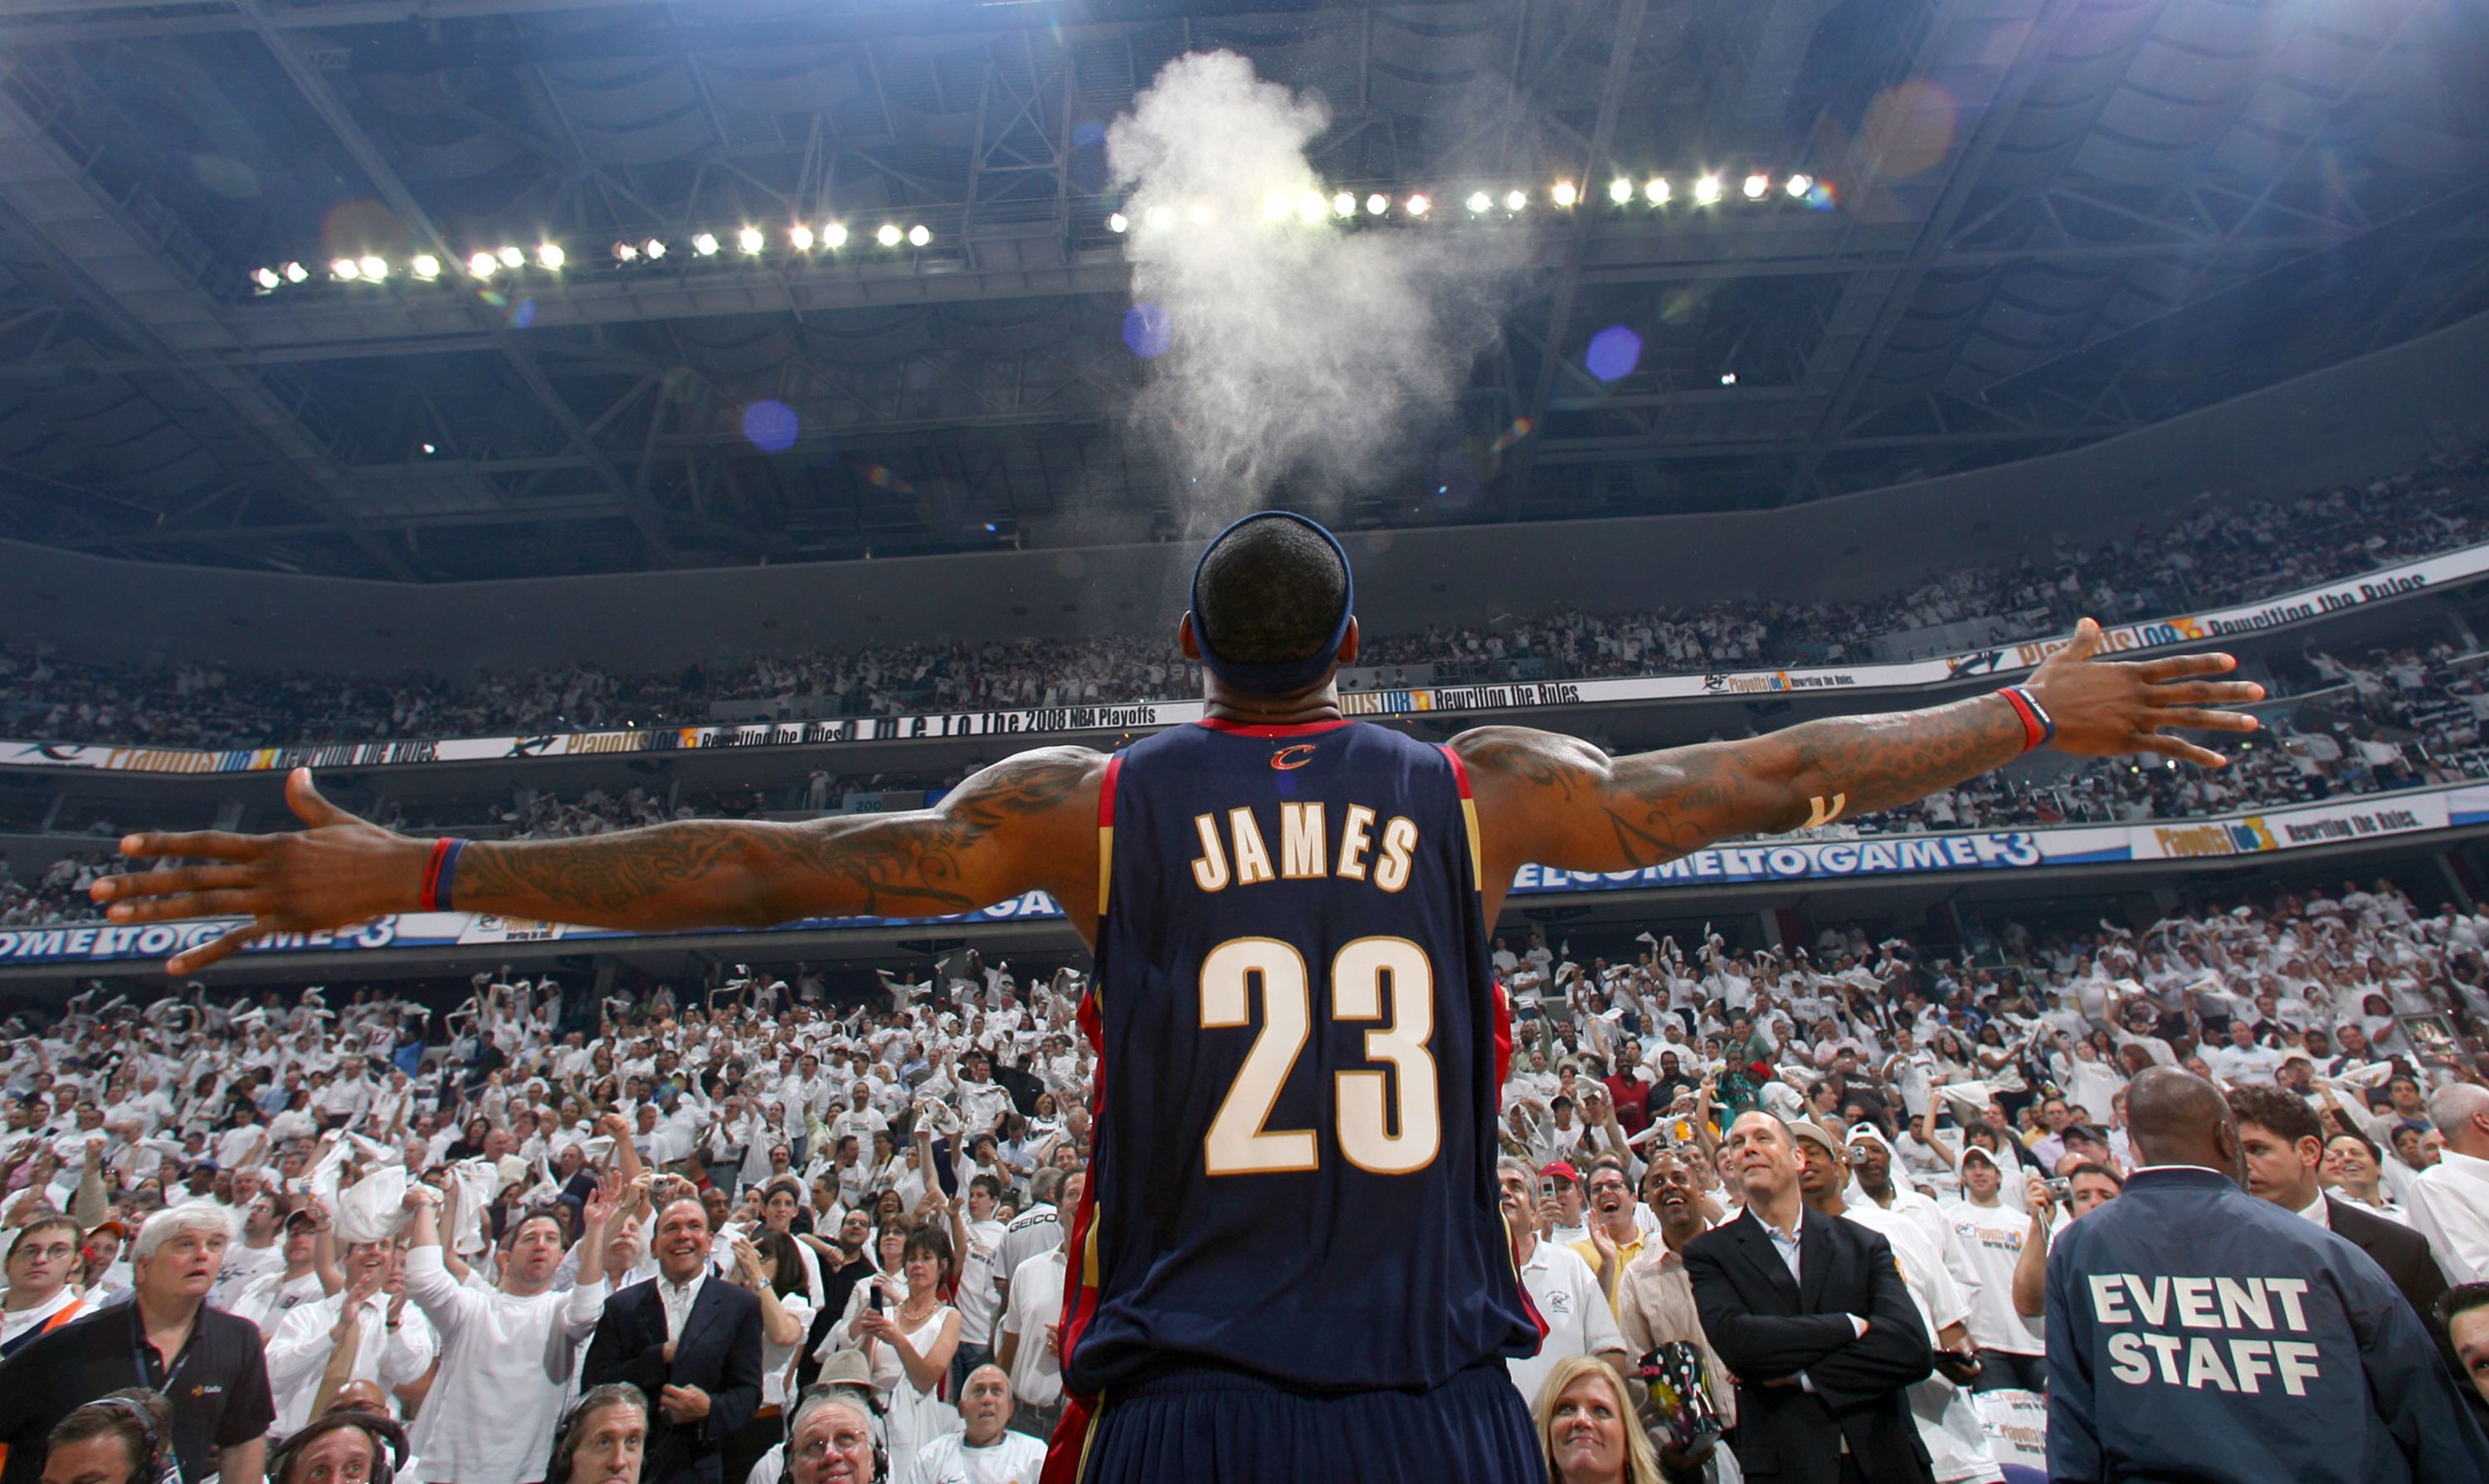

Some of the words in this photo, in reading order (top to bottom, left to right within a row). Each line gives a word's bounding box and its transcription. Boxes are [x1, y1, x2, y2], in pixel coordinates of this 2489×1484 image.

[1511, 684, 1534, 706] the
[1025, 707, 1067, 732] 2008
[1069, 705, 1095, 727] NBA
[1098, 706, 1157, 727] Playoffs
[855, 800, 882, 812] 200
[1191, 801, 1418, 893] JAMES
[1819, 838, 1980, 873] GAME
[1199, 936, 1441, 1176] 23
[1009, 1212, 1058, 1233] GEICO
[2087, 1272, 2309, 1332] EVENT
[2107, 1332, 2321, 1397] STAFF
